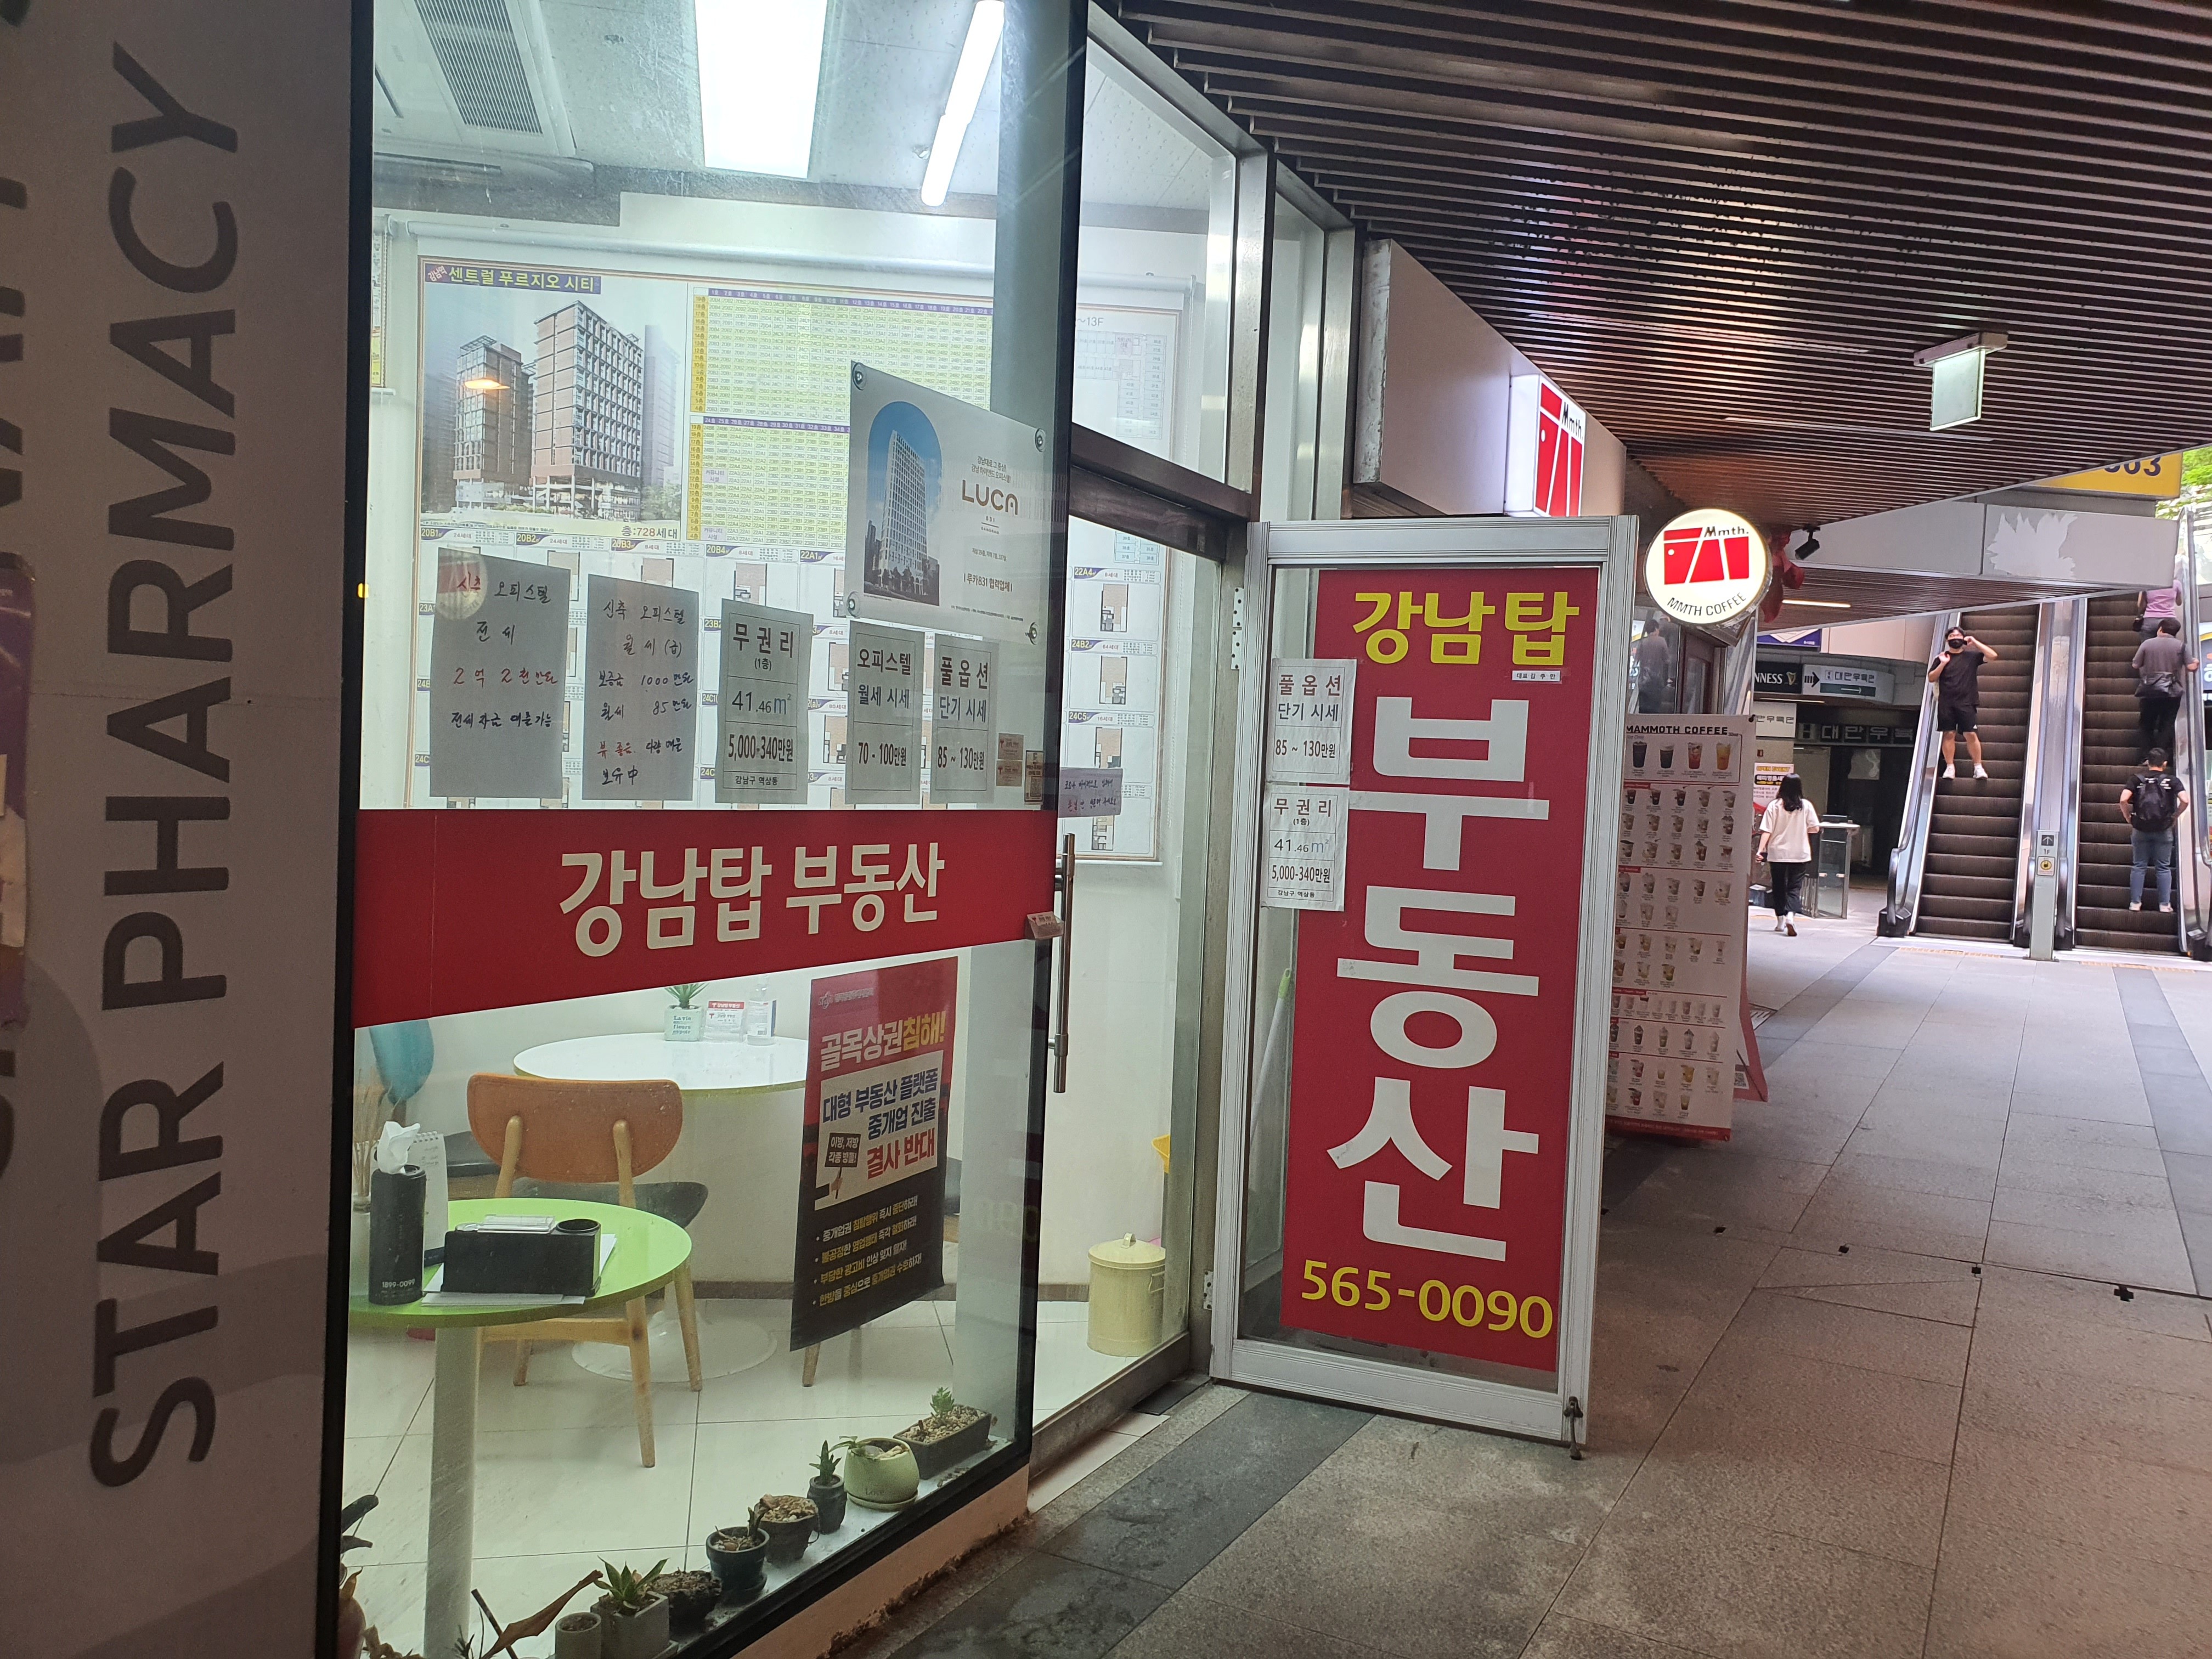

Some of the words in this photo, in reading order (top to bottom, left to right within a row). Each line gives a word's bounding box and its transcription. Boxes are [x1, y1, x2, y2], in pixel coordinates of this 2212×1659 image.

[449, 267, 494, 285] 센트럴
[498, 270, 561, 288] 푸르지오
[565, 276, 594, 291] 시티
[962, 479, 1018, 515] LUCA
[103, 42, 238, 1010] PHARMACY
[494, 582, 551, 603] 오피스텔
[967, 573, 988, 587] 루카831
[989, 578, 1010, 592] 협력업체
[603, 599, 627, 620] 신축
[640, 605, 685, 625] 오피스텔
[1667, 597, 1702, 616] MMTH
[1706, 592, 1747, 616] COFFEE
[1352, 591, 1579, 665] 강남탑
[754, 658, 772, 671] (1층)
[857, 649, 911, 675] 오피스텔
[599, 670, 623, 687] 보증금
[858, 685, 881, 707] 월세
[887, 688, 909, 709] 시세
[940, 696, 960, 721] 단기
[966, 699, 986, 723] 시세
[601, 702, 624, 721] 월세
[1278, 703, 1304, 721] 단기
[1311, 704, 1338, 721] 시세
[1626, 726, 1680, 734] MAMMOTH
[1685, 726, 1728, 735] COFFEE
[646, 739, 662, 754] 다량
[666, 738, 682, 752] 매물
[729, 734, 793, 763] 5,000-340만원
[859, 742, 868, 764] 70
[879, 743, 906, 766] 100만원
[938, 746, 947, 768] 85
[960, 747, 984, 770] 130만원
[1276, 740, 1287, 755] 85
[1304, 740, 1335, 758] 130만원
[735, 776, 755, 785] 강남구
[758, 777, 778, 786] 역삼동
[1272, 865, 1330, 883] 5,000-340만원
[559, 845, 772, 957] 강남탑
[786, 842, 945, 935] 부동산
[1327, 697, 1549, 1261] 부동산
[823, 1091, 851, 1123] 대형
[855, 1079, 898, 1113] 부동산
[900, 1068, 938, 1101] 플랫폼
[868, 1105, 908, 1140] 중개업
[911, 1098, 935, 1126] 진출
[867, 1140, 900, 1179] 결사
[904, 1128, 934, 1166] 반대
[823, 1222, 851, 1242] 중개업권
[853, 1211, 878, 1231] 침탈행위
[879, 1206, 891, 1220] 즉시
[822, 1243, 850, 1263] 불공정한
[853, 1232, 878, 1252] 영업행태
[878, 1227, 891, 1240] 즉각
[91, 1062, 224, 1488] STAR
[845, 1258, 865, 1276] 광고비
[866, 1252, 878, 1267] 인상
[879, 1248, 892, 1261] 잊지
[382, 1278, 415, 1288] 1899-0099
[820, 1288, 842, 1306] 한방을
[843, 1277, 871, 1297] 중심으로
[872, 1265, 896, 1285] 중개업권
[1302, 1259, 1553, 1338] 565-0090
